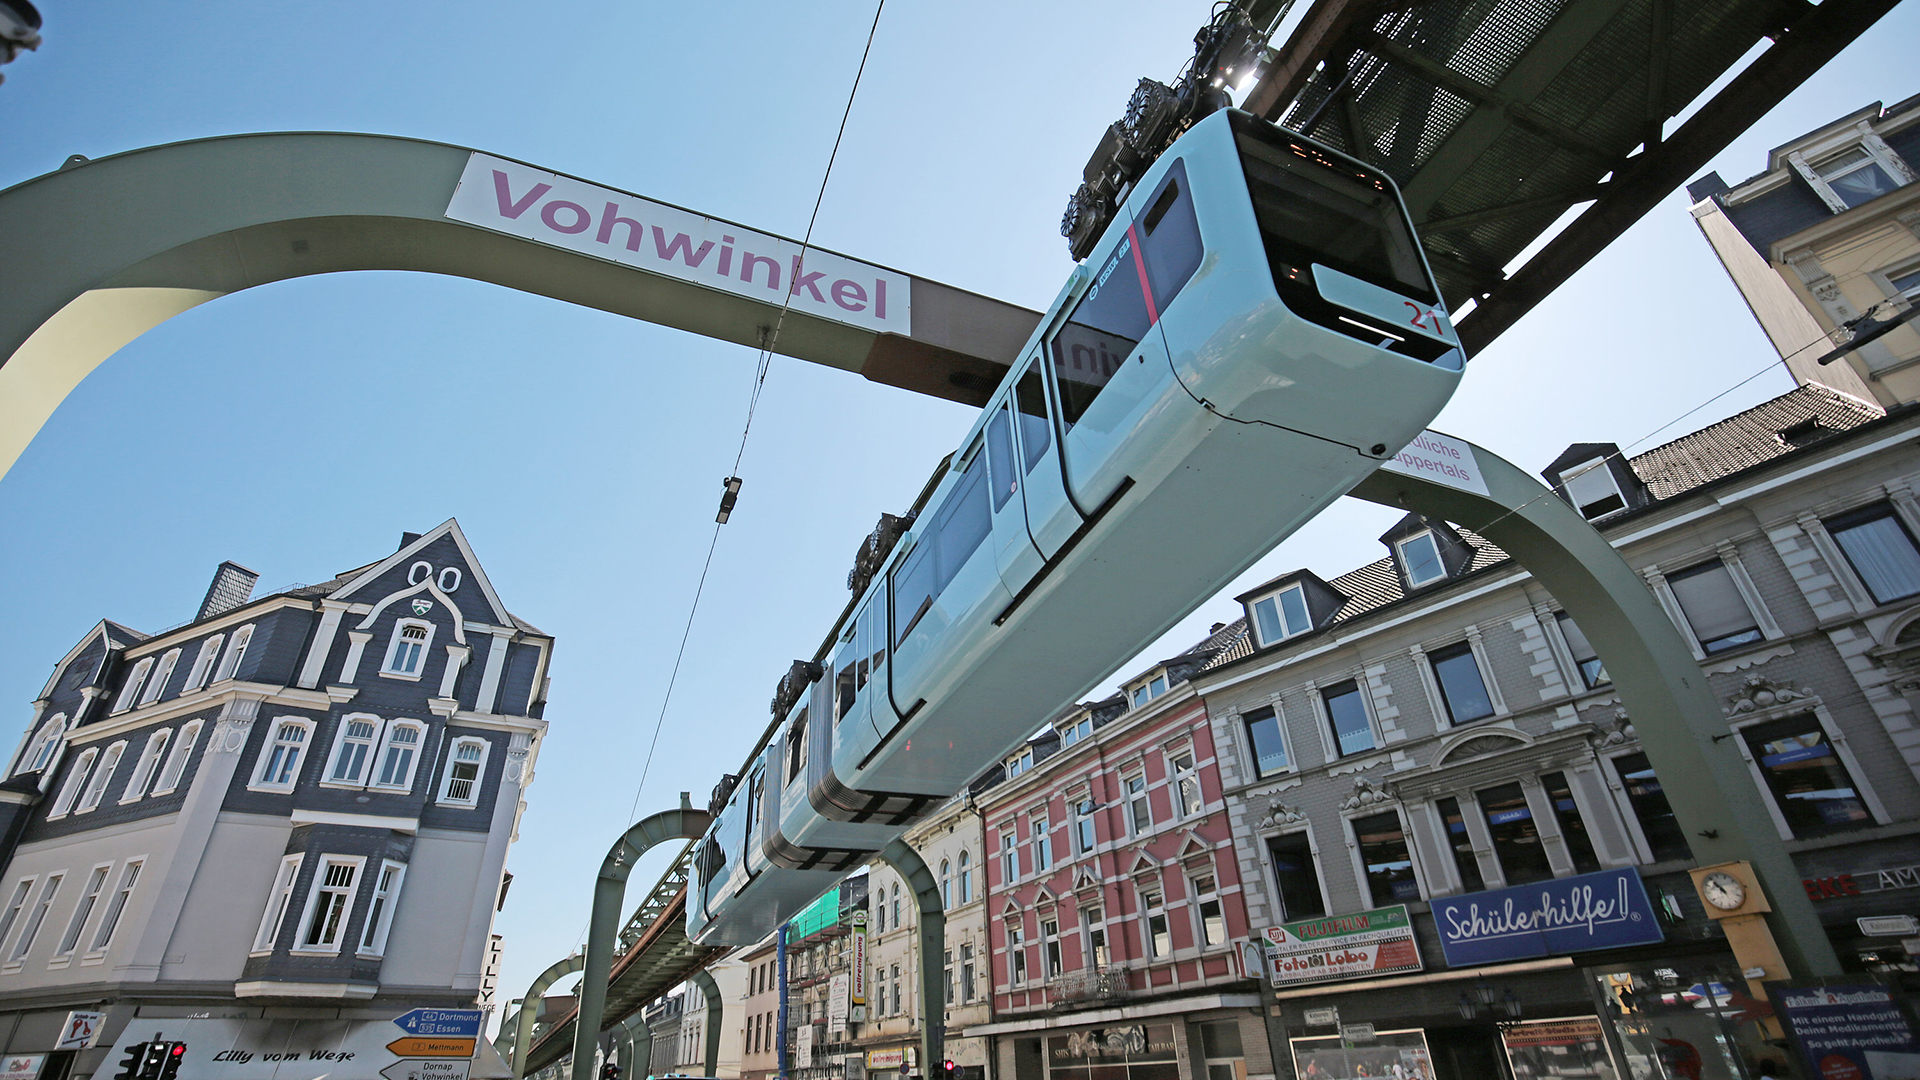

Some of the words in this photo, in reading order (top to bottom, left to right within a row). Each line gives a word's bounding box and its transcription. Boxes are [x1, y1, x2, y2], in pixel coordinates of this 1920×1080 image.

[491, 168, 887, 320] Vohwinkel
[1403, 301, 1444, 335] 21
[1409, 436, 1461, 460] dliche
[1394, 450, 1471, 481] uppertals
[1802, 873, 1861, 901] EKE
[1298, 914, 1371, 940] FUJIFILM
[1266, 944, 1298, 954] DIGITALER
[1299, 936, 1349, 950] BILDERSERVICE
[1359, 927, 1410, 941] FACHQUALITÄT
[481, 941, 502, 1002] LILLY
[1274, 957, 1309, 973] Foto
[1325, 949, 1369, 967] Lobo
[1276, 969, 1316, 980] FARBBILDER
[1317, 968, 1327, 976] AB
[1339, 962, 1372, 973] MINUTEN
[439, 1012, 479, 1022] Dortmund
[1791, 1016, 1810, 1025] Mit
[1811, 1014, 1846, 1024] einem
[1847, 1010, 1901, 1024] Handgriff
[436, 1024, 461, 1033] Essen
[1794, 1026, 1827, 1036] Deine
[1828, 1021, 1909, 1034] Medikamente!
[1807, 1040, 1822, 1049] So
[1824, 1038, 1849, 1050] geht
[212, 1050, 254, 1064] Lilly
[263, 1052, 301, 1062] vom
[309, 1050, 356, 1063] Wege
[423, 1062, 453, 1072] Dornap
[422, 1072, 463, 1080] Vohwinkel
